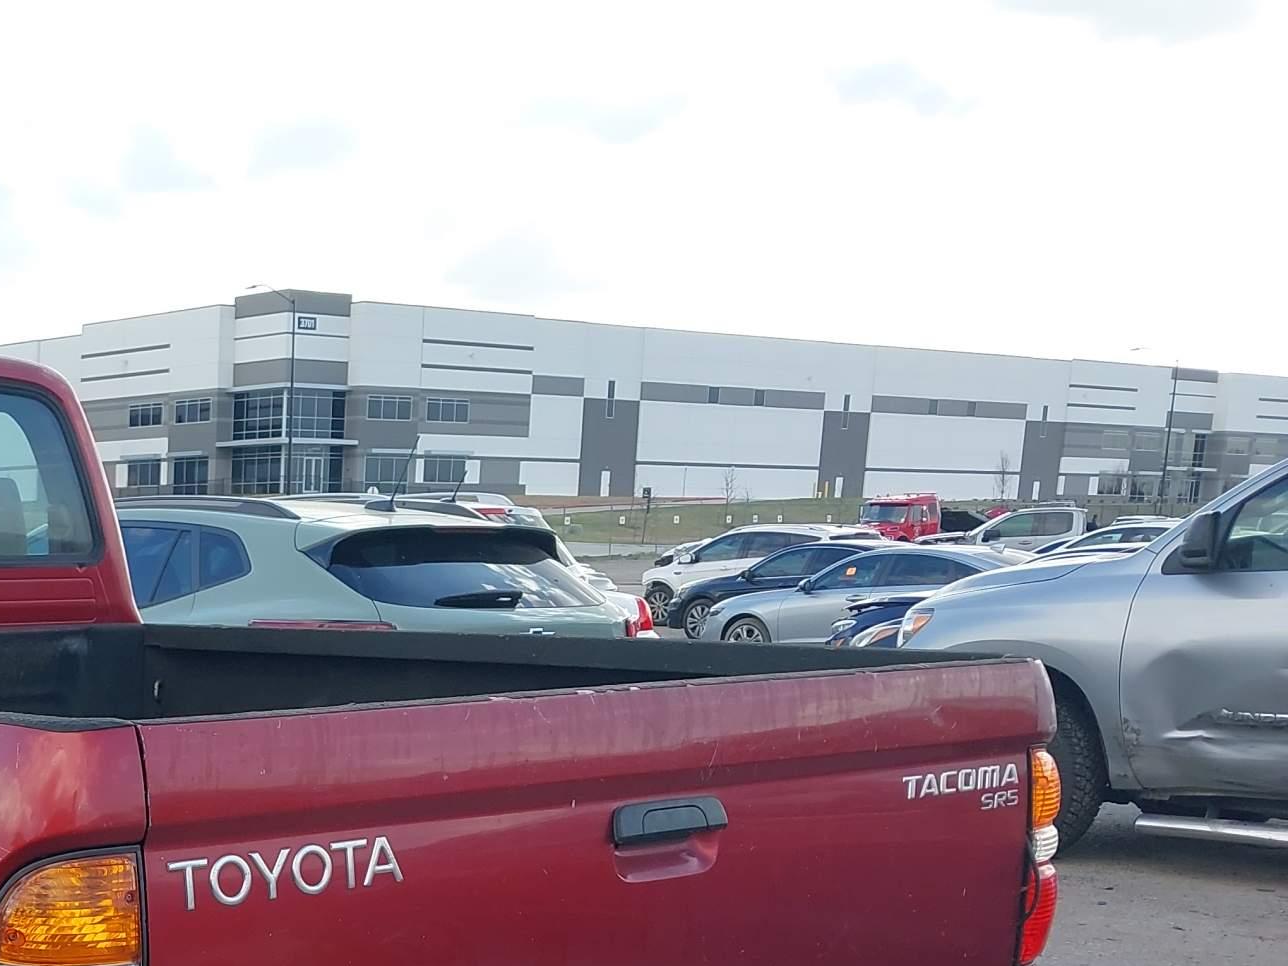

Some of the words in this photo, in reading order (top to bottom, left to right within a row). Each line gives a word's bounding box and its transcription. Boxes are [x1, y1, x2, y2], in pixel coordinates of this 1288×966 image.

[902, 763, 1019, 799] TACOMA
[980, 789, 1019, 810] SR5
[167, 836, 404, 911] TOYOTA
